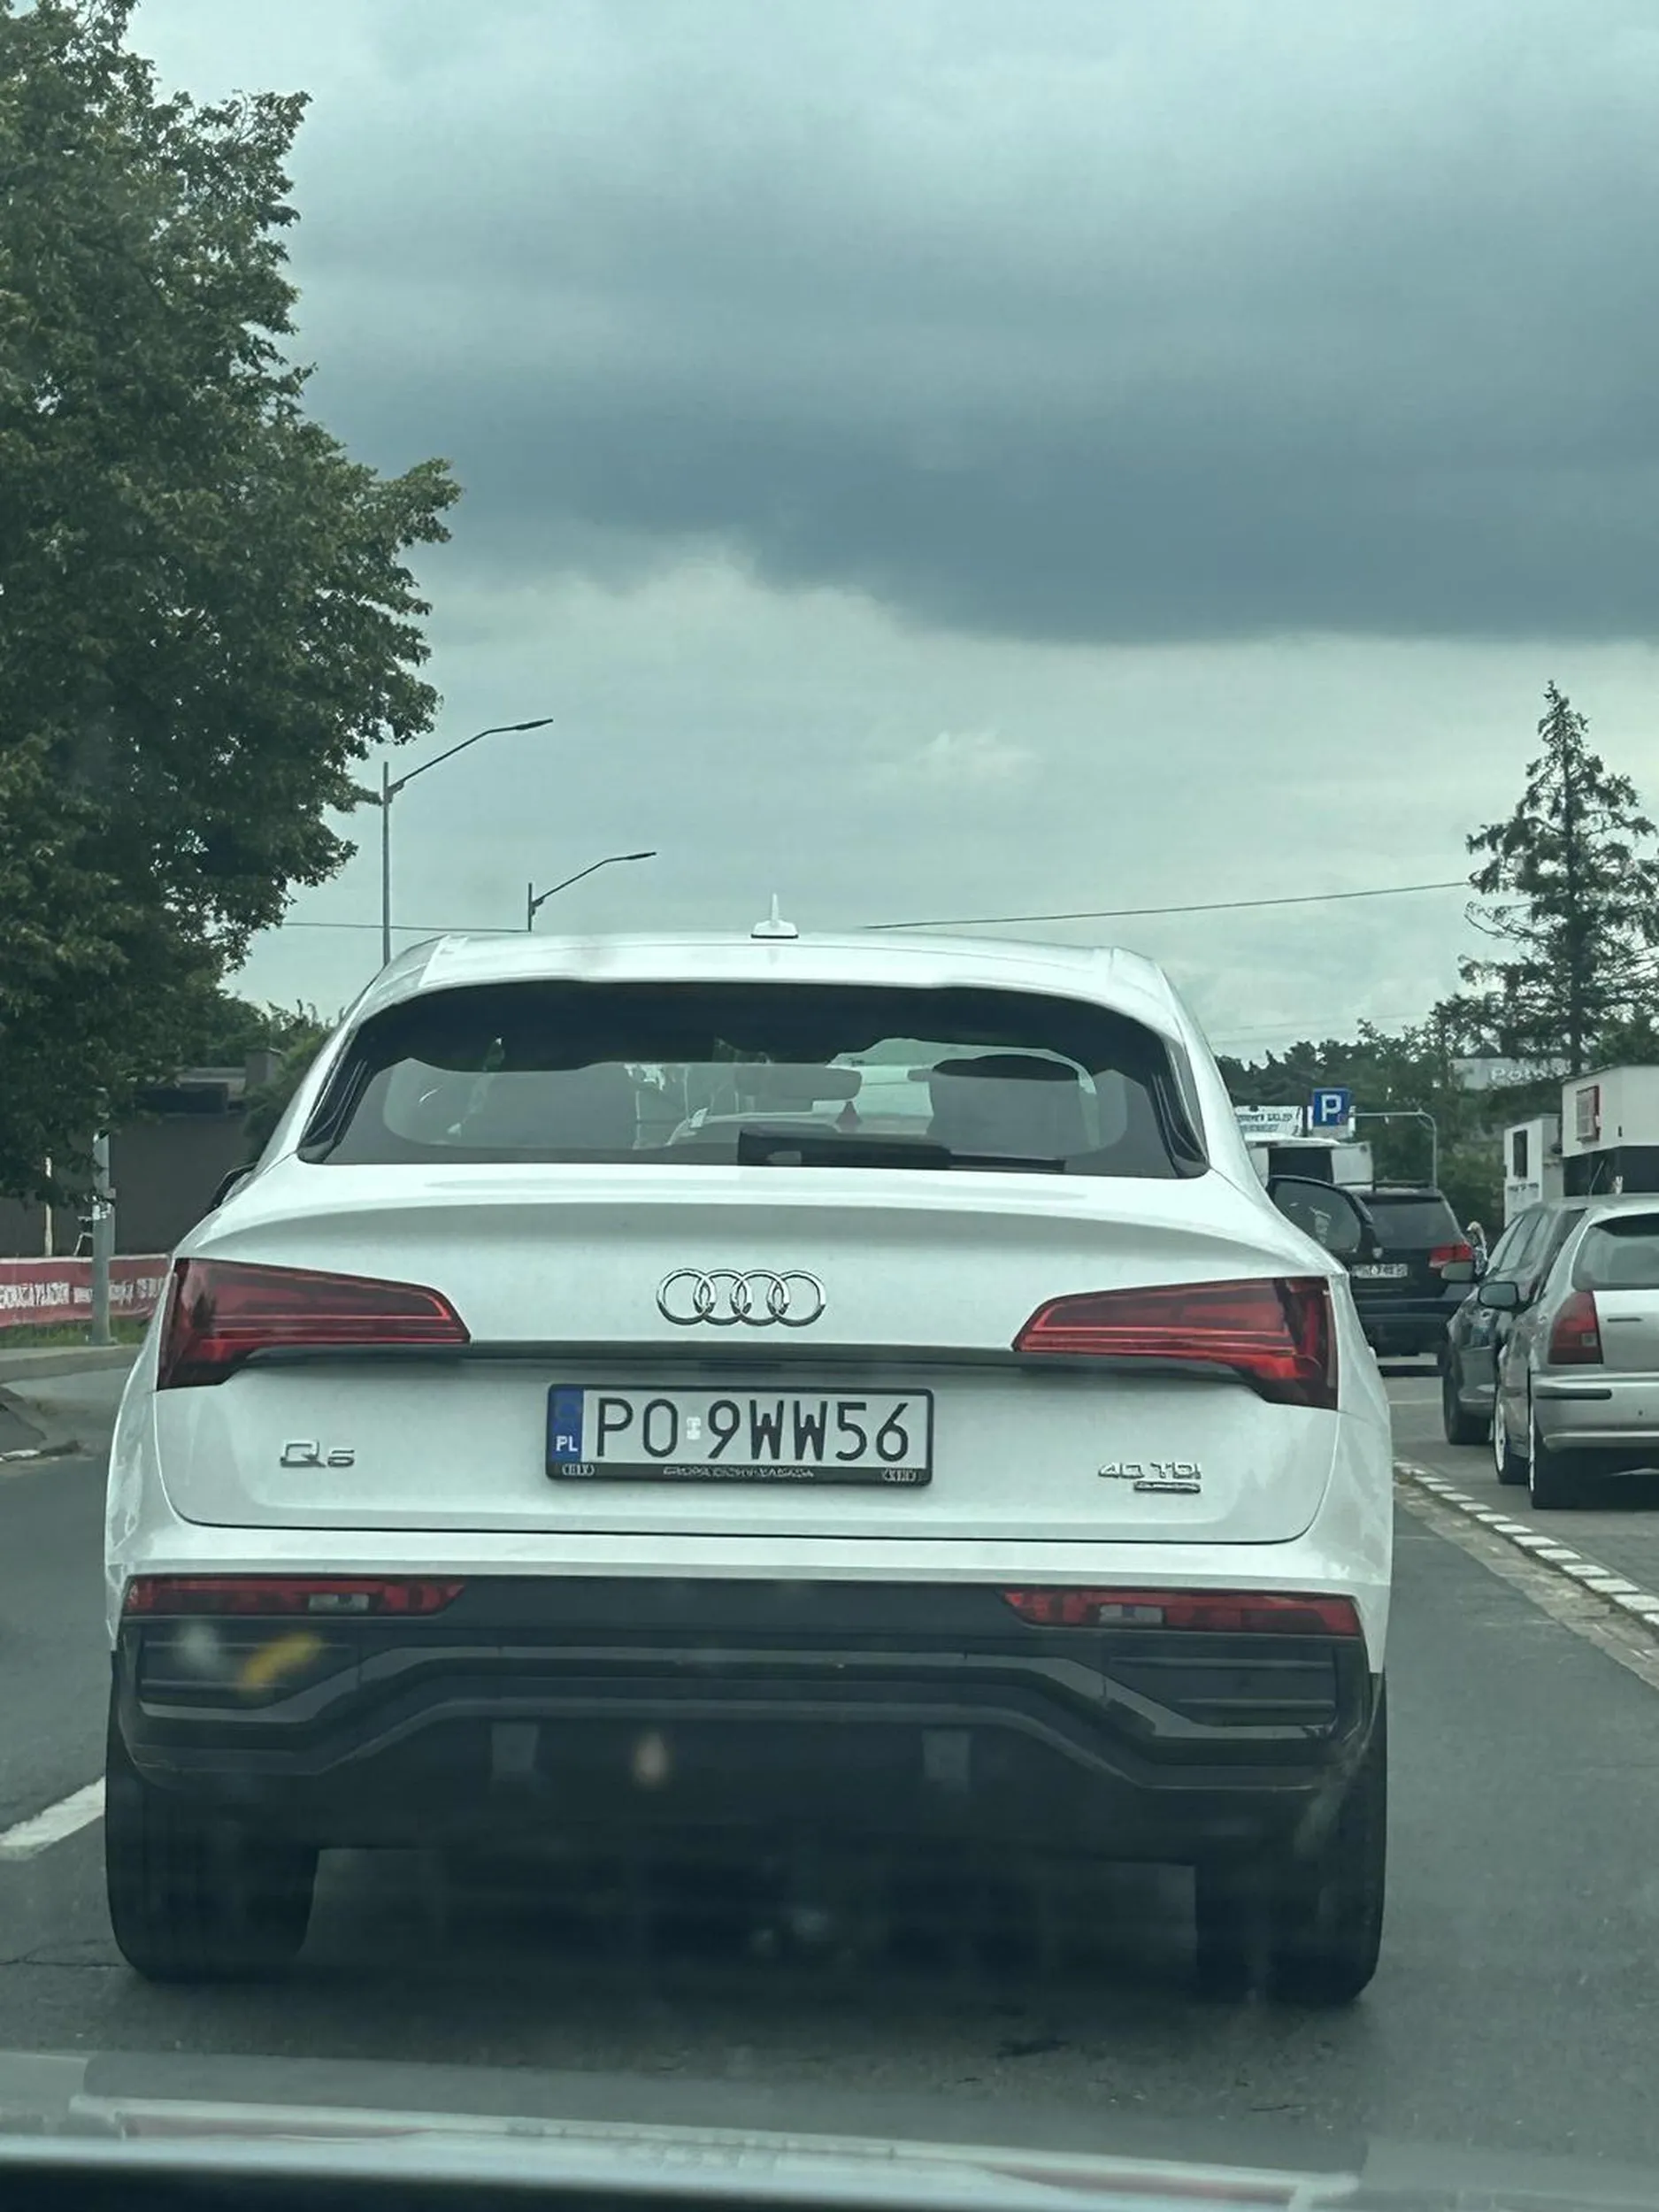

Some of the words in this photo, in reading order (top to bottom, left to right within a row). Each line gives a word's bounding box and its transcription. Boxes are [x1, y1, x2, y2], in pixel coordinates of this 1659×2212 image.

[1321, 1094, 1341, 1122] P
[597, 1398, 679, 1458] PO
[708, 1400, 910, 1462] 9WW56
[557, 1436, 578, 1452] PL
[1098, 1462, 1145, 1479] 40
